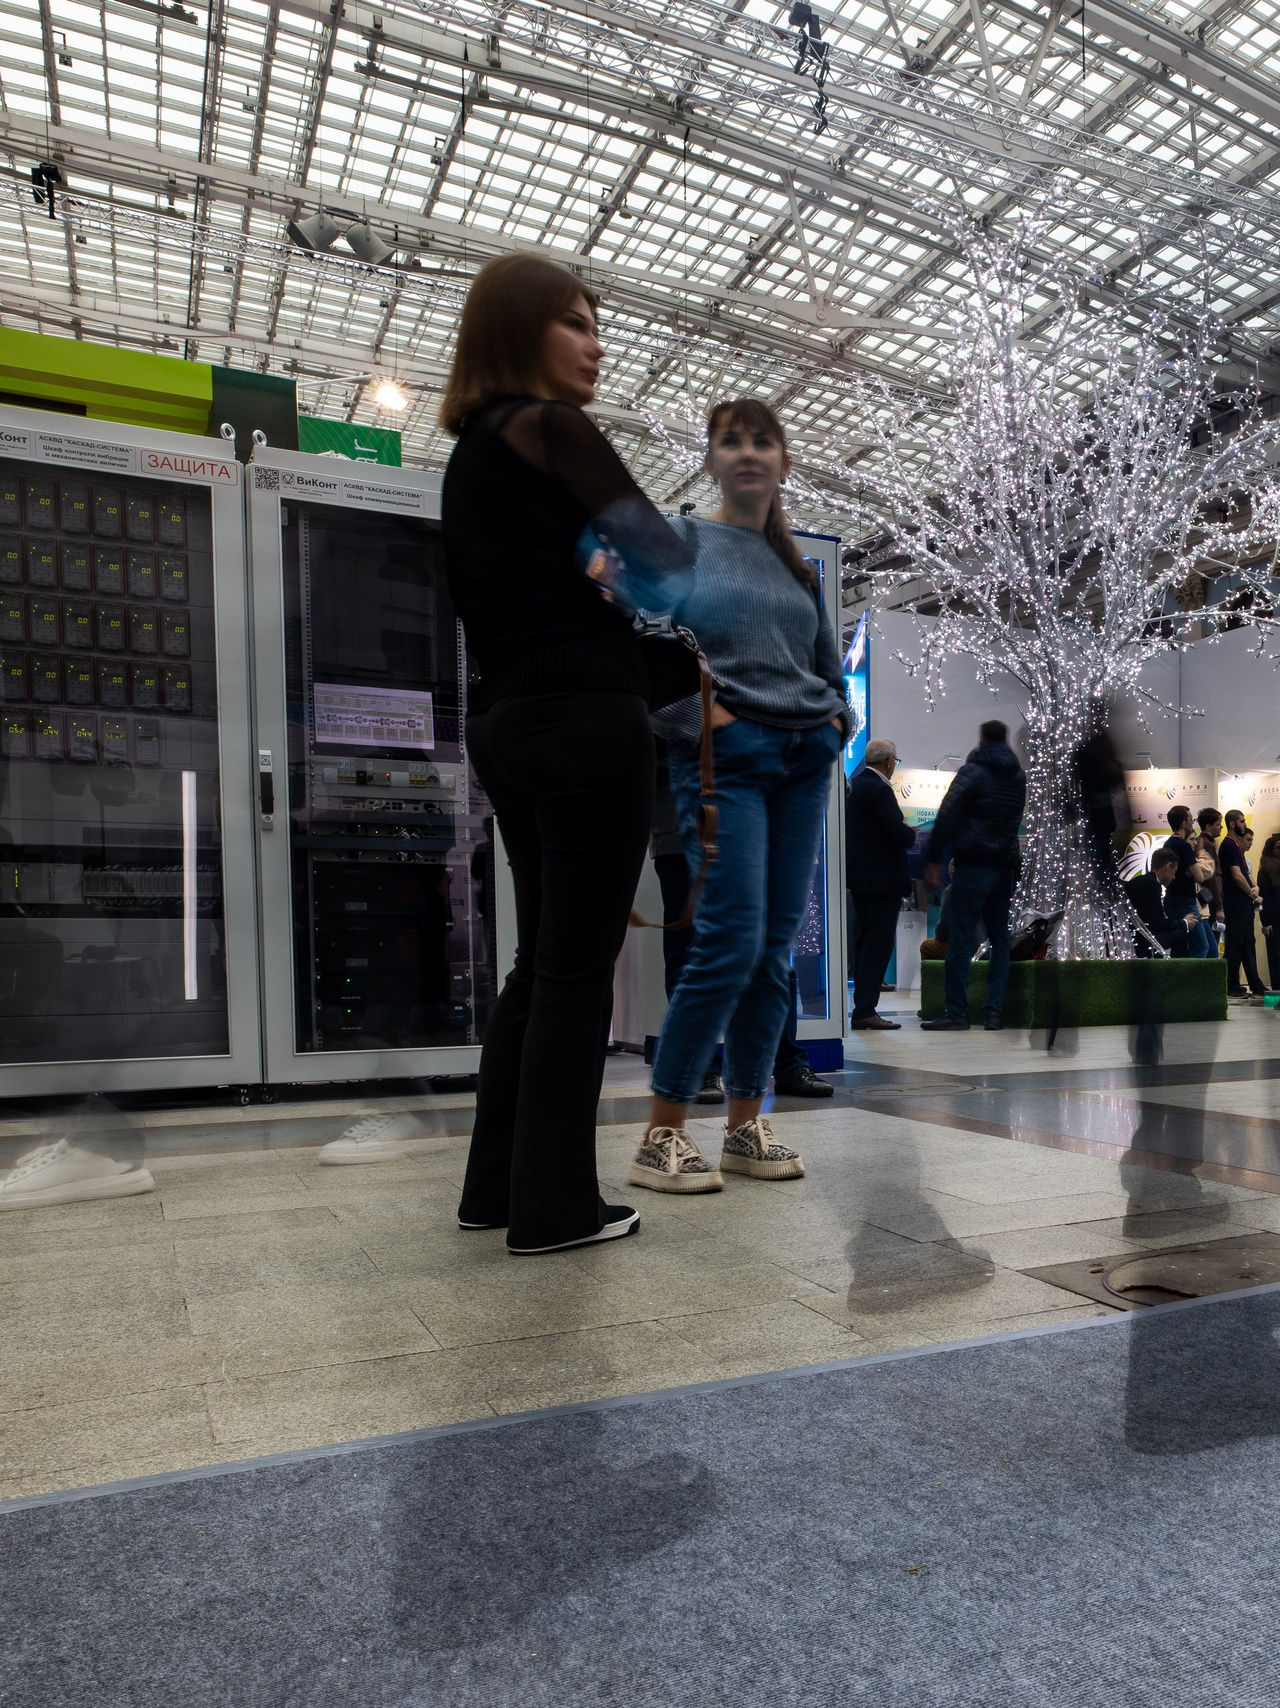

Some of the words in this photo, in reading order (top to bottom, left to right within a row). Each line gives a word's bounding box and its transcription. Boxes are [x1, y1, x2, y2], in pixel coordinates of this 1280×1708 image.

[38, 435, 63, 445] АСКВД
[43, 445, 63, 453] Шкаф
[64, 448, 96, 459] контроля
[97, 453, 129, 463] вибрации
[51, 453, 98, 465] механических
[99, 459, 128, 469] величин
[147, 455, 231, 480] ЗАЩИТА
[296, 476, 338, 490] ВиКонт
[344, 483, 364, 491] АСКВД
[346, 493, 364, 501] Шкаф
[365, 496, 421, 509] коммуникационный
